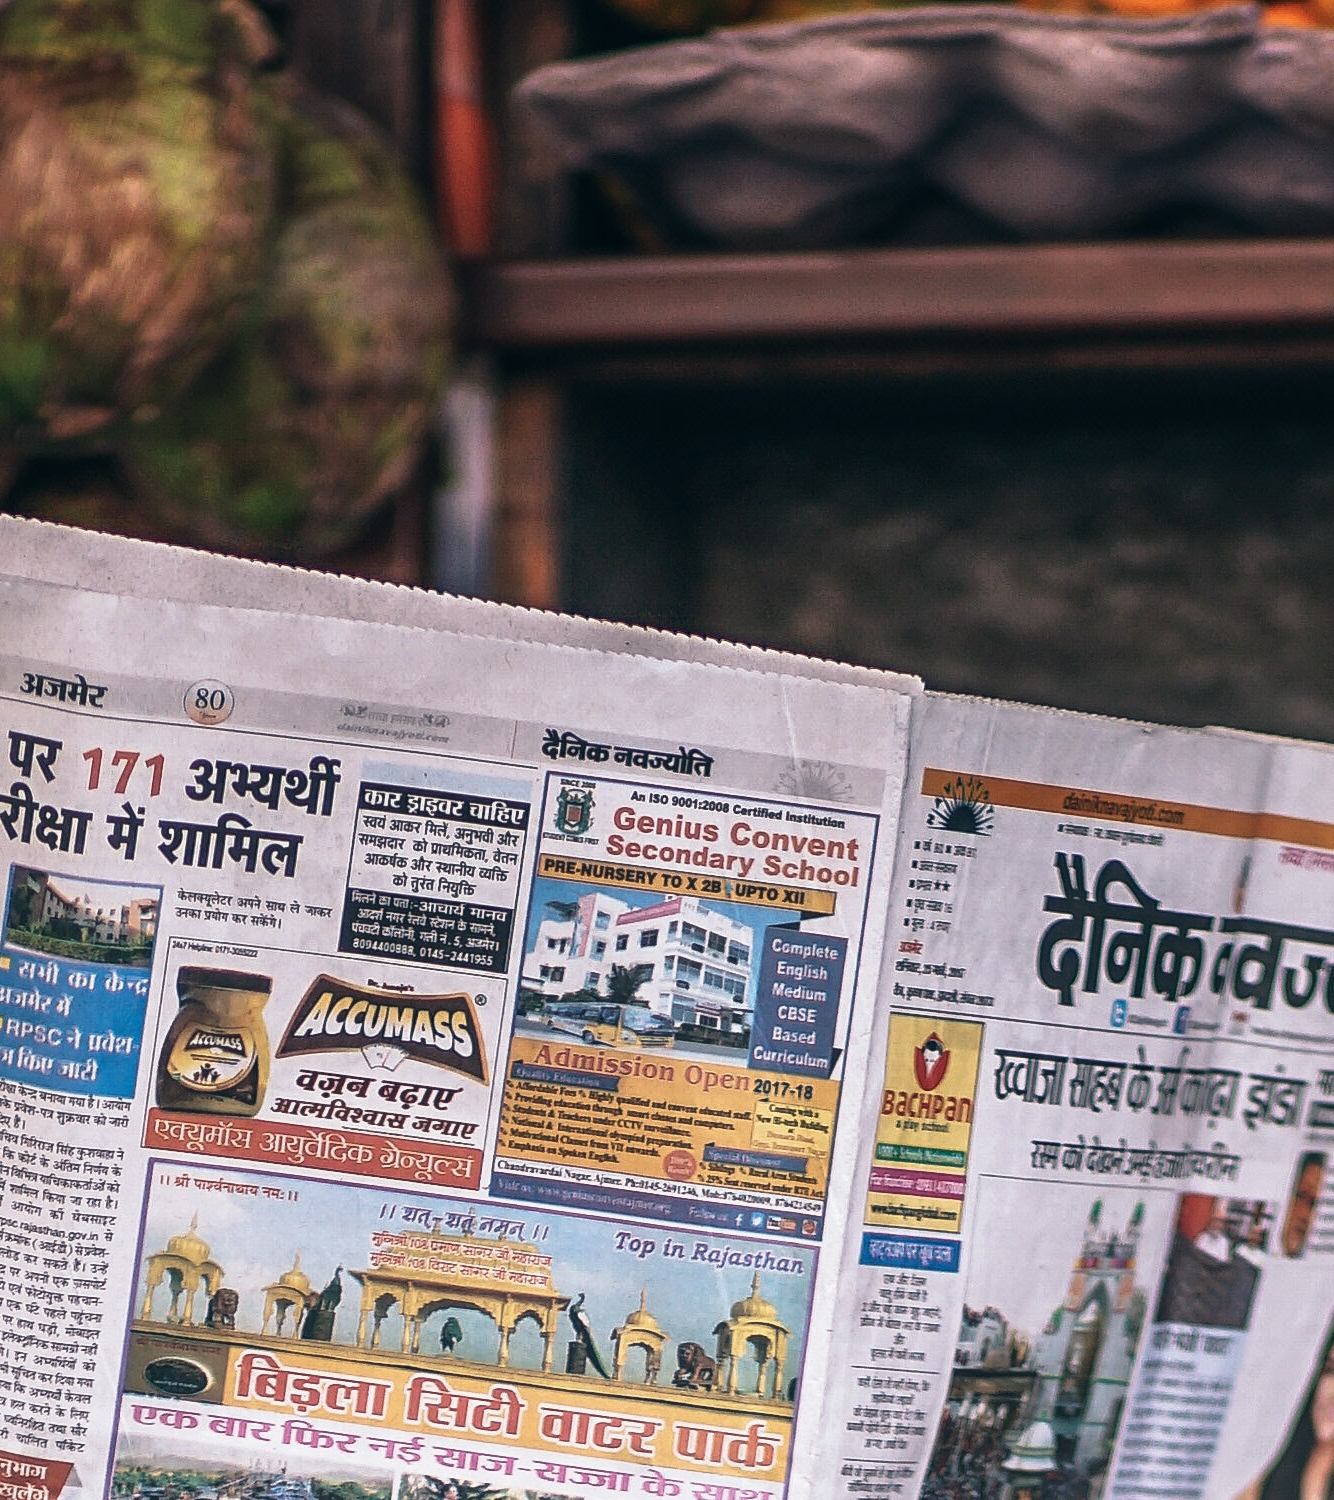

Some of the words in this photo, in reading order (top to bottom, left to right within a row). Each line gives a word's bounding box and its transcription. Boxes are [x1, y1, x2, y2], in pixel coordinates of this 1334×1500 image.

[19, 673, 109, 708] अजमेर
[195, 688, 225, 710] 80
[8, 729, 62, 783] पर
[83, 747, 165, 797] 171
[185, 755, 341, 816] अभ्यर्थी
[541, 727, 612, 762] दैनिक
[613, 746, 714, 779] नवज्योति
[364, 789, 402, 808] कार
[407, 794, 465, 817] ड्राइवर
[469, 801, 525, 825] चाहिए
[630, 790, 646, 802] An
[648, 792, 669, 805] ISO
[671, 795, 730, 814] 9001:2008
[732, 804, 783, 821] Certified
[785, 811, 845, 829] Institution
[106, 801, 145, 861] में
[158, 813, 304, 878] शामिल
[613, 806, 720, 843] Genius
[730, 822, 859, 862] Convent
[606, 834, 755, 878] Secondary
[762, 855, 860, 888] School
[772, 938, 838, 960] Complete
[1037, 851, 1215, 1006] दैनिक
[772, 982, 826, 1002] Medium
[777, 961, 827, 980] English
[294, 993, 473, 1057] ACCUMASS
[772, 1026, 816, 1045] Based
[778, 1005, 817, 1023] CBSE
[533, 1044, 674, 1083] Admission
[685, 1065, 750, 1091] Open
[754, 1079, 813, 1099] 2017-18
[753, 1046, 827, 1069] Curriculum
[296, 1069, 377, 1099] वज़न
[378, 1079, 463, 1111] बढ़ाए
[270, 1097, 410, 1130] आत्मविश्वास
[411, 1115, 479, 1140] जगाए
[613, 1231, 656, 1259] Top
[662, 1236, 685, 1259] in
[690, 1241, 804, 1274] Rajasthan
[237, 1353, 391, 1419] बिड़ला
[406, 1376, 525, 1438] सिटी
[540, 1404, 662, 1459] वाटर
[675, 1419, 781, 1471] पार्क
[130, 1404, 202, 1430] एक
[206, 1414, 276, 1442] बार
[280, 1419, 362, 1454] फिर
[365, 1436, 426, 1465] नई
[431, 1445, 635, 1492] साज-सज्जा
[639, 1468, 685, 1497] के
